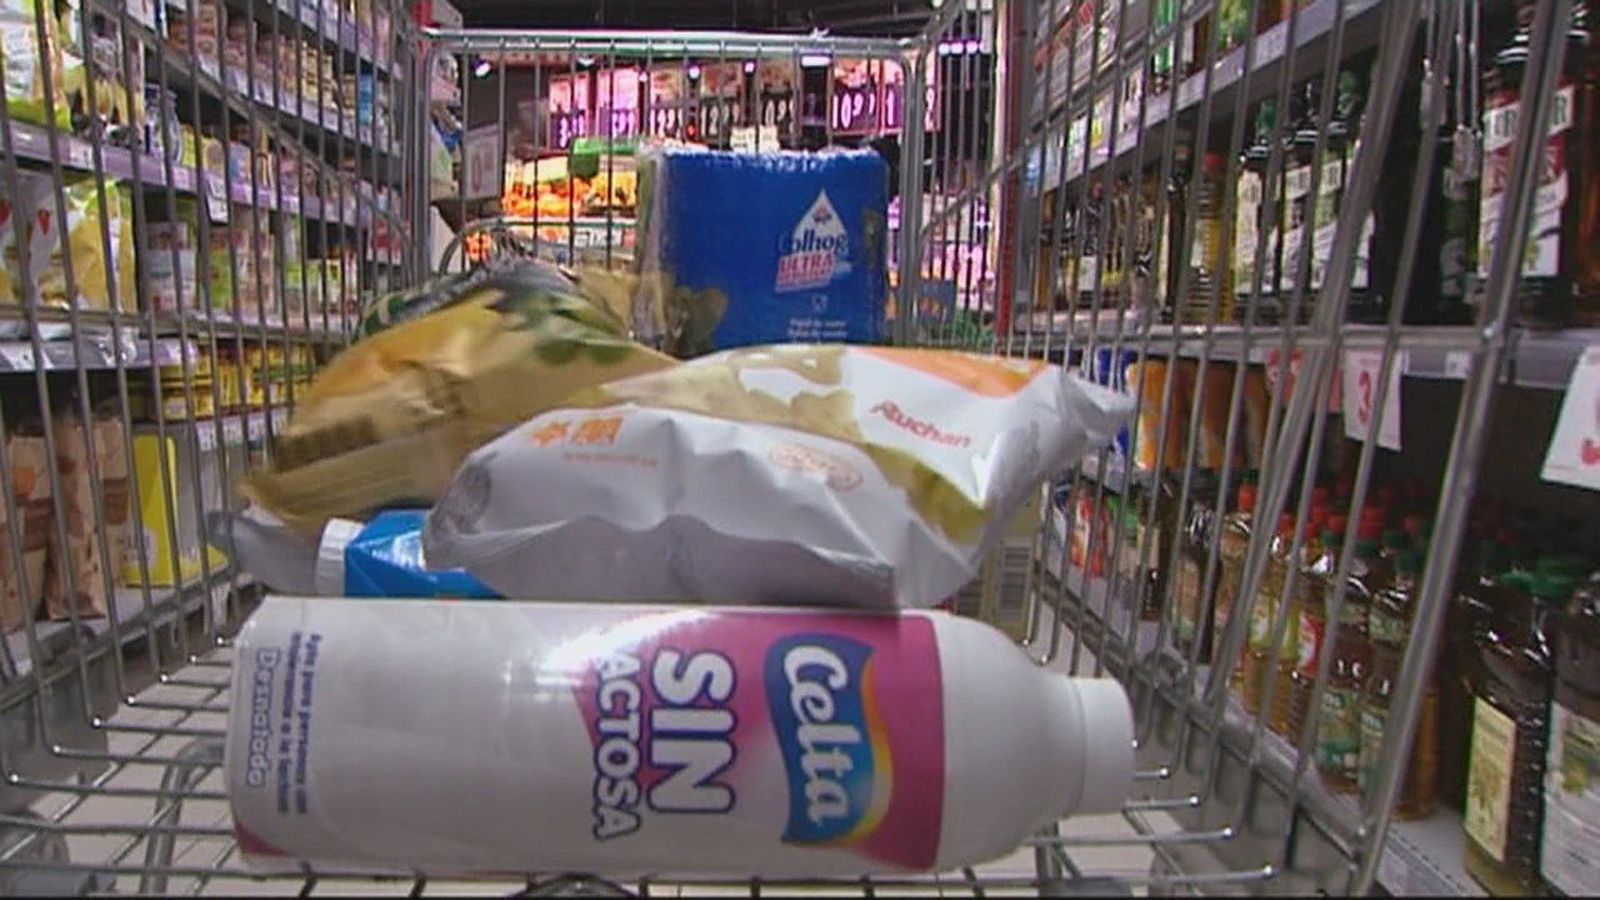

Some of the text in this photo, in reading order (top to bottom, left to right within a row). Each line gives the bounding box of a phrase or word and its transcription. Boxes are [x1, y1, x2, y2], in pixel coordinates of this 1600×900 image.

[593, 643, 642, 841] ACTOSA
[647, 648, 738, 813] SIN
[783, 644, 862, 826] Celta
